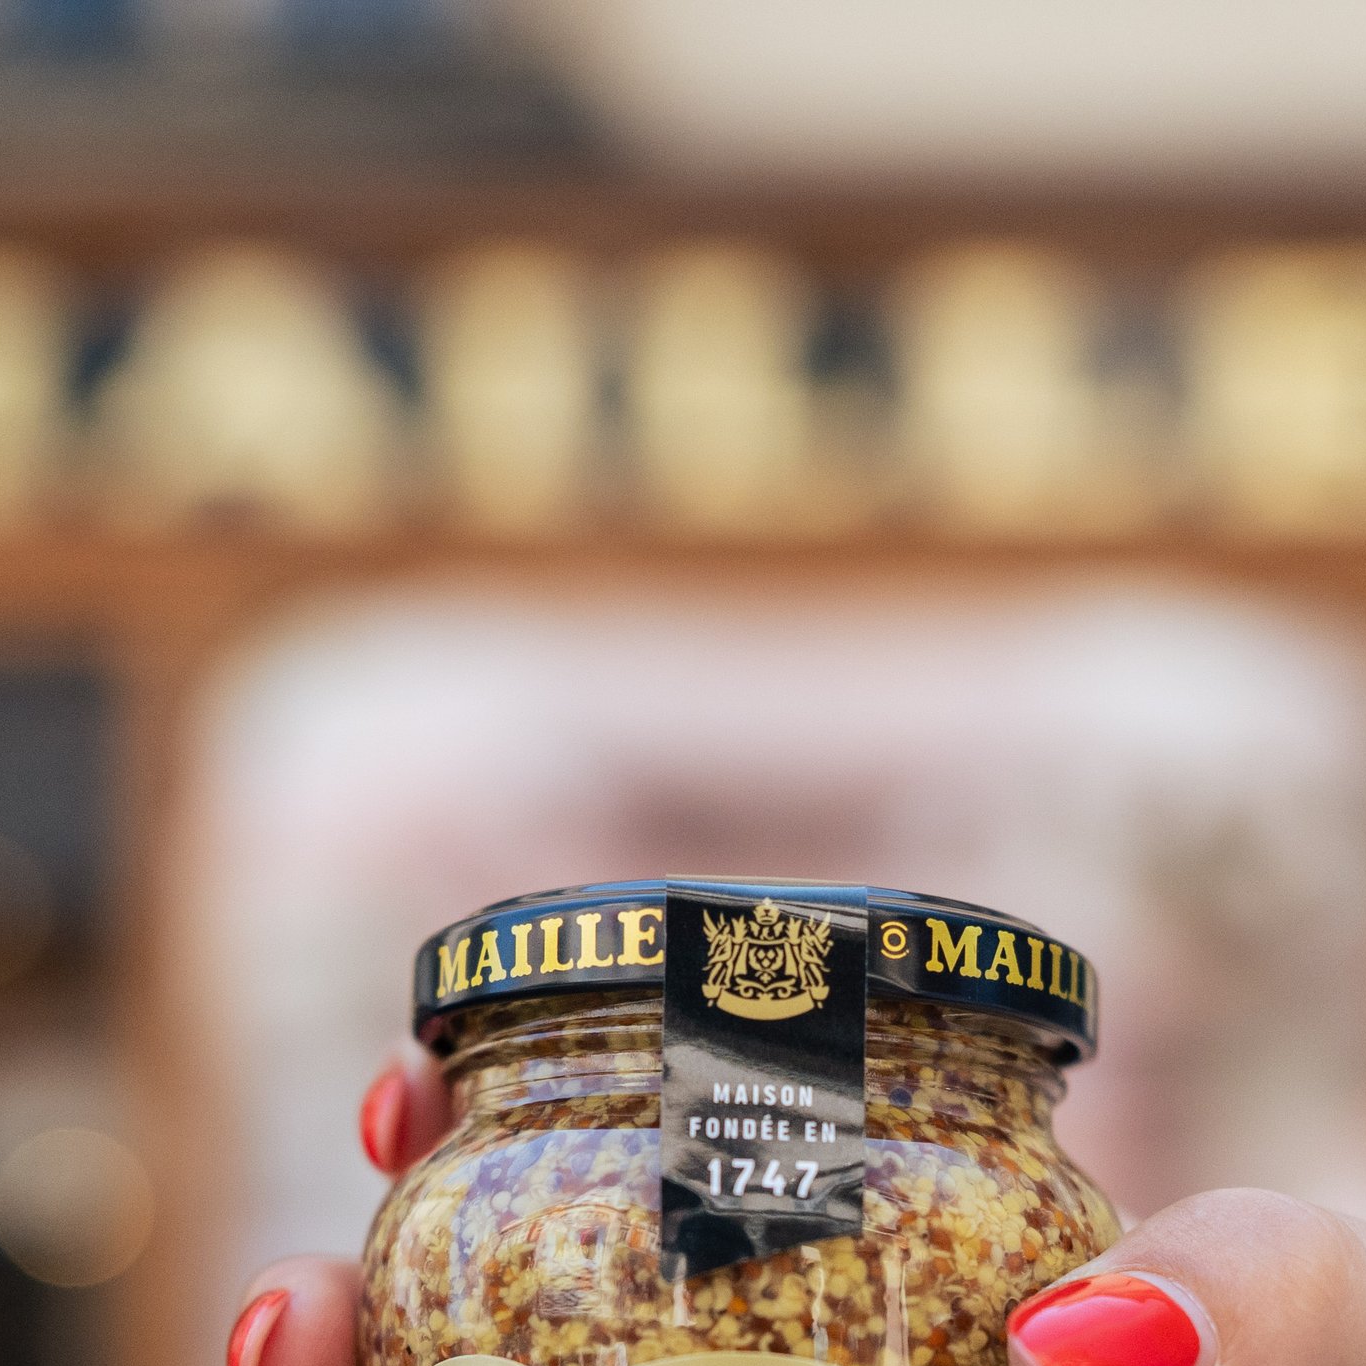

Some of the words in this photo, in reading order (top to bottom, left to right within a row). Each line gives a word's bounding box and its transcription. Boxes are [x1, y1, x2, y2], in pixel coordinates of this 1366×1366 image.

[436, 908, 665, 999] MAILLE
[713, 1082, 813, 1107] MAISON
[689, 1114, 790, 1141] FONDÉE
[804, 1121, 836, 1143] EN
[707, 1158, 819, 1198] 1747
